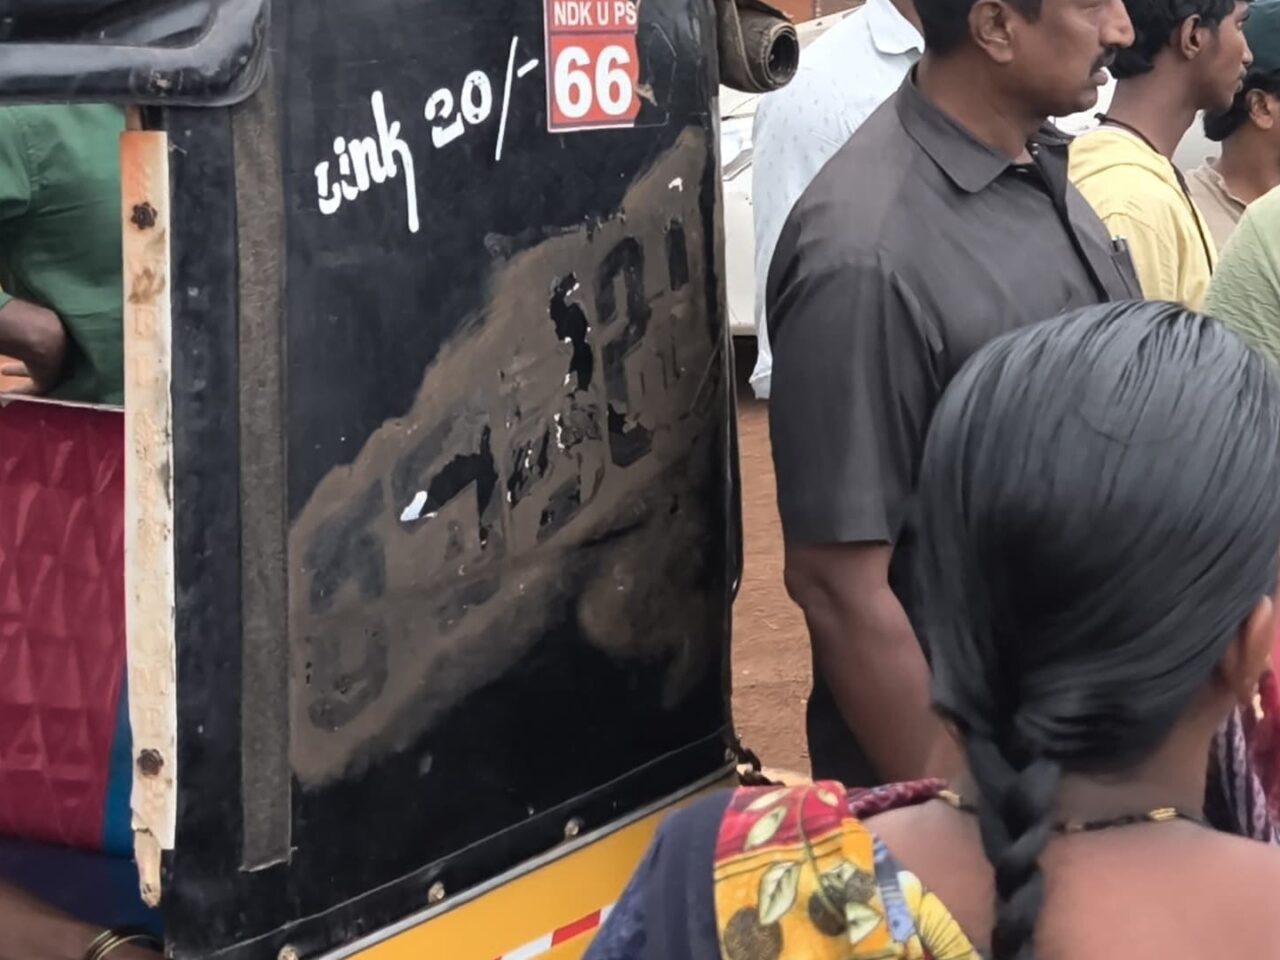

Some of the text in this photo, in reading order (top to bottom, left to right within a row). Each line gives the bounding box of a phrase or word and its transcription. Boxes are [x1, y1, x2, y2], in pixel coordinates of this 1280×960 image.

[553, 0, 637, 26] NDK U PS
[553, 45, 633, 119] 66
